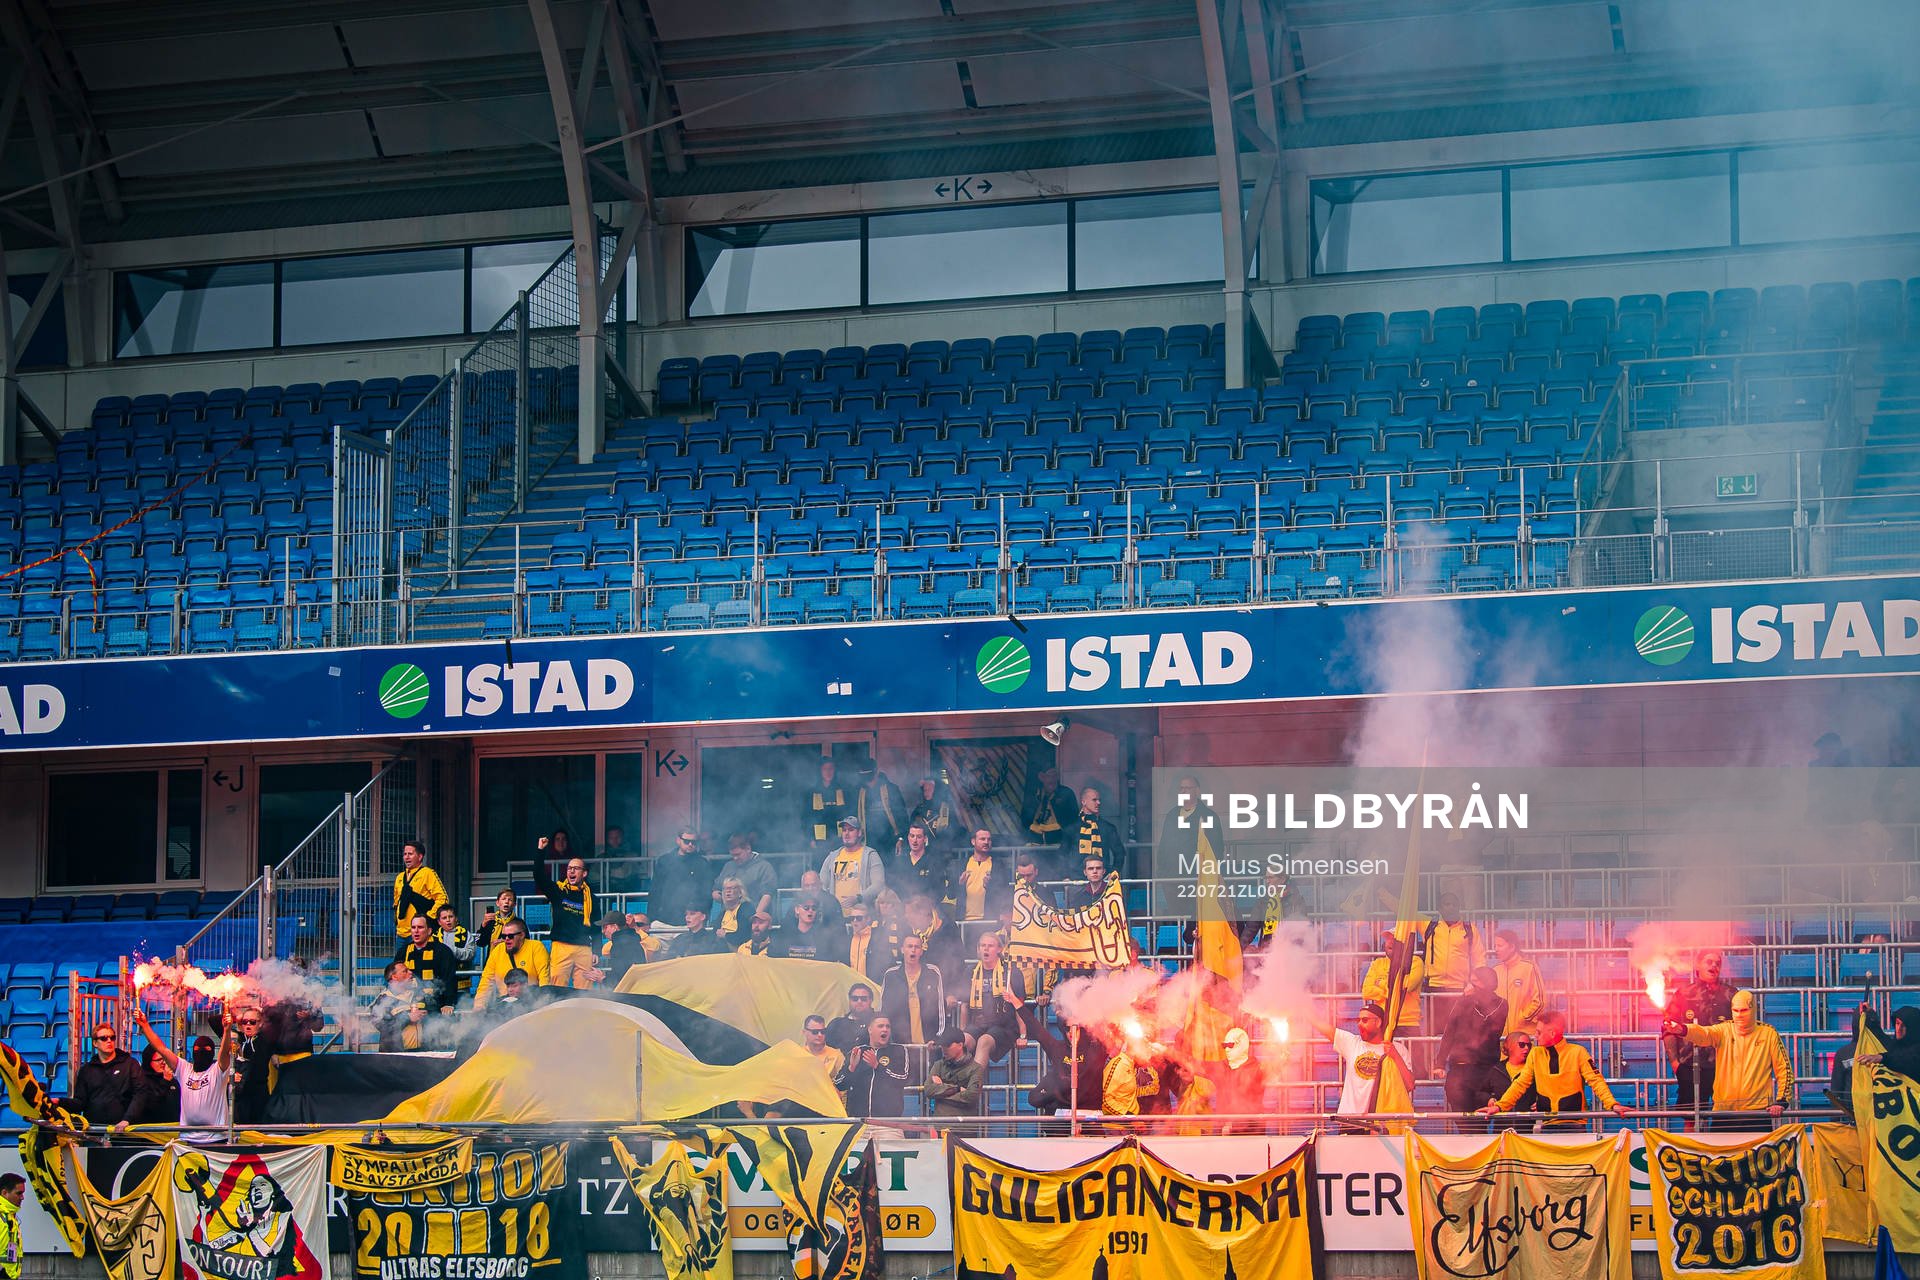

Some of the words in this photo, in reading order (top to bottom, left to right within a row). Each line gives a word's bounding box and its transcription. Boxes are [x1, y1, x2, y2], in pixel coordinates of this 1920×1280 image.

[954, 177, 973, 201] K
[1711, 600, 1920, 664] ISTAD
[1046, 631, 1253, 692] ISTAD
[445, 658, 634, 718] ISTAD
[229, 765, 244, 792] J
[655, 749, 677, 777] K
[343, 1155, 418, 1173] SYMPATI
[343, 1168, 364, 1183] DE
[1659, 1137, 1798, 1183] SEKTION
[961, 1163, 1301, 1232] GULIGANERNA
[1669, 1174, 1801, 1216] SCHLÄTTA
[499, 1201, 551, 1260] 18
[744, 1213, 779, 1231] OG
[885, 1213, 920, 1232] ØR
[1430, 1178, 1594, 1278] Elfsborg
[1677, 1213, 1797, 1267] 2016
[1108, 1231, 1148, 1255] 1991
[214, 1253, 273, 1280] TOUR!
[380, 1257, 442, 1280] ULTRAS
[445, 1256, 529, 1279] ELFSBORG
